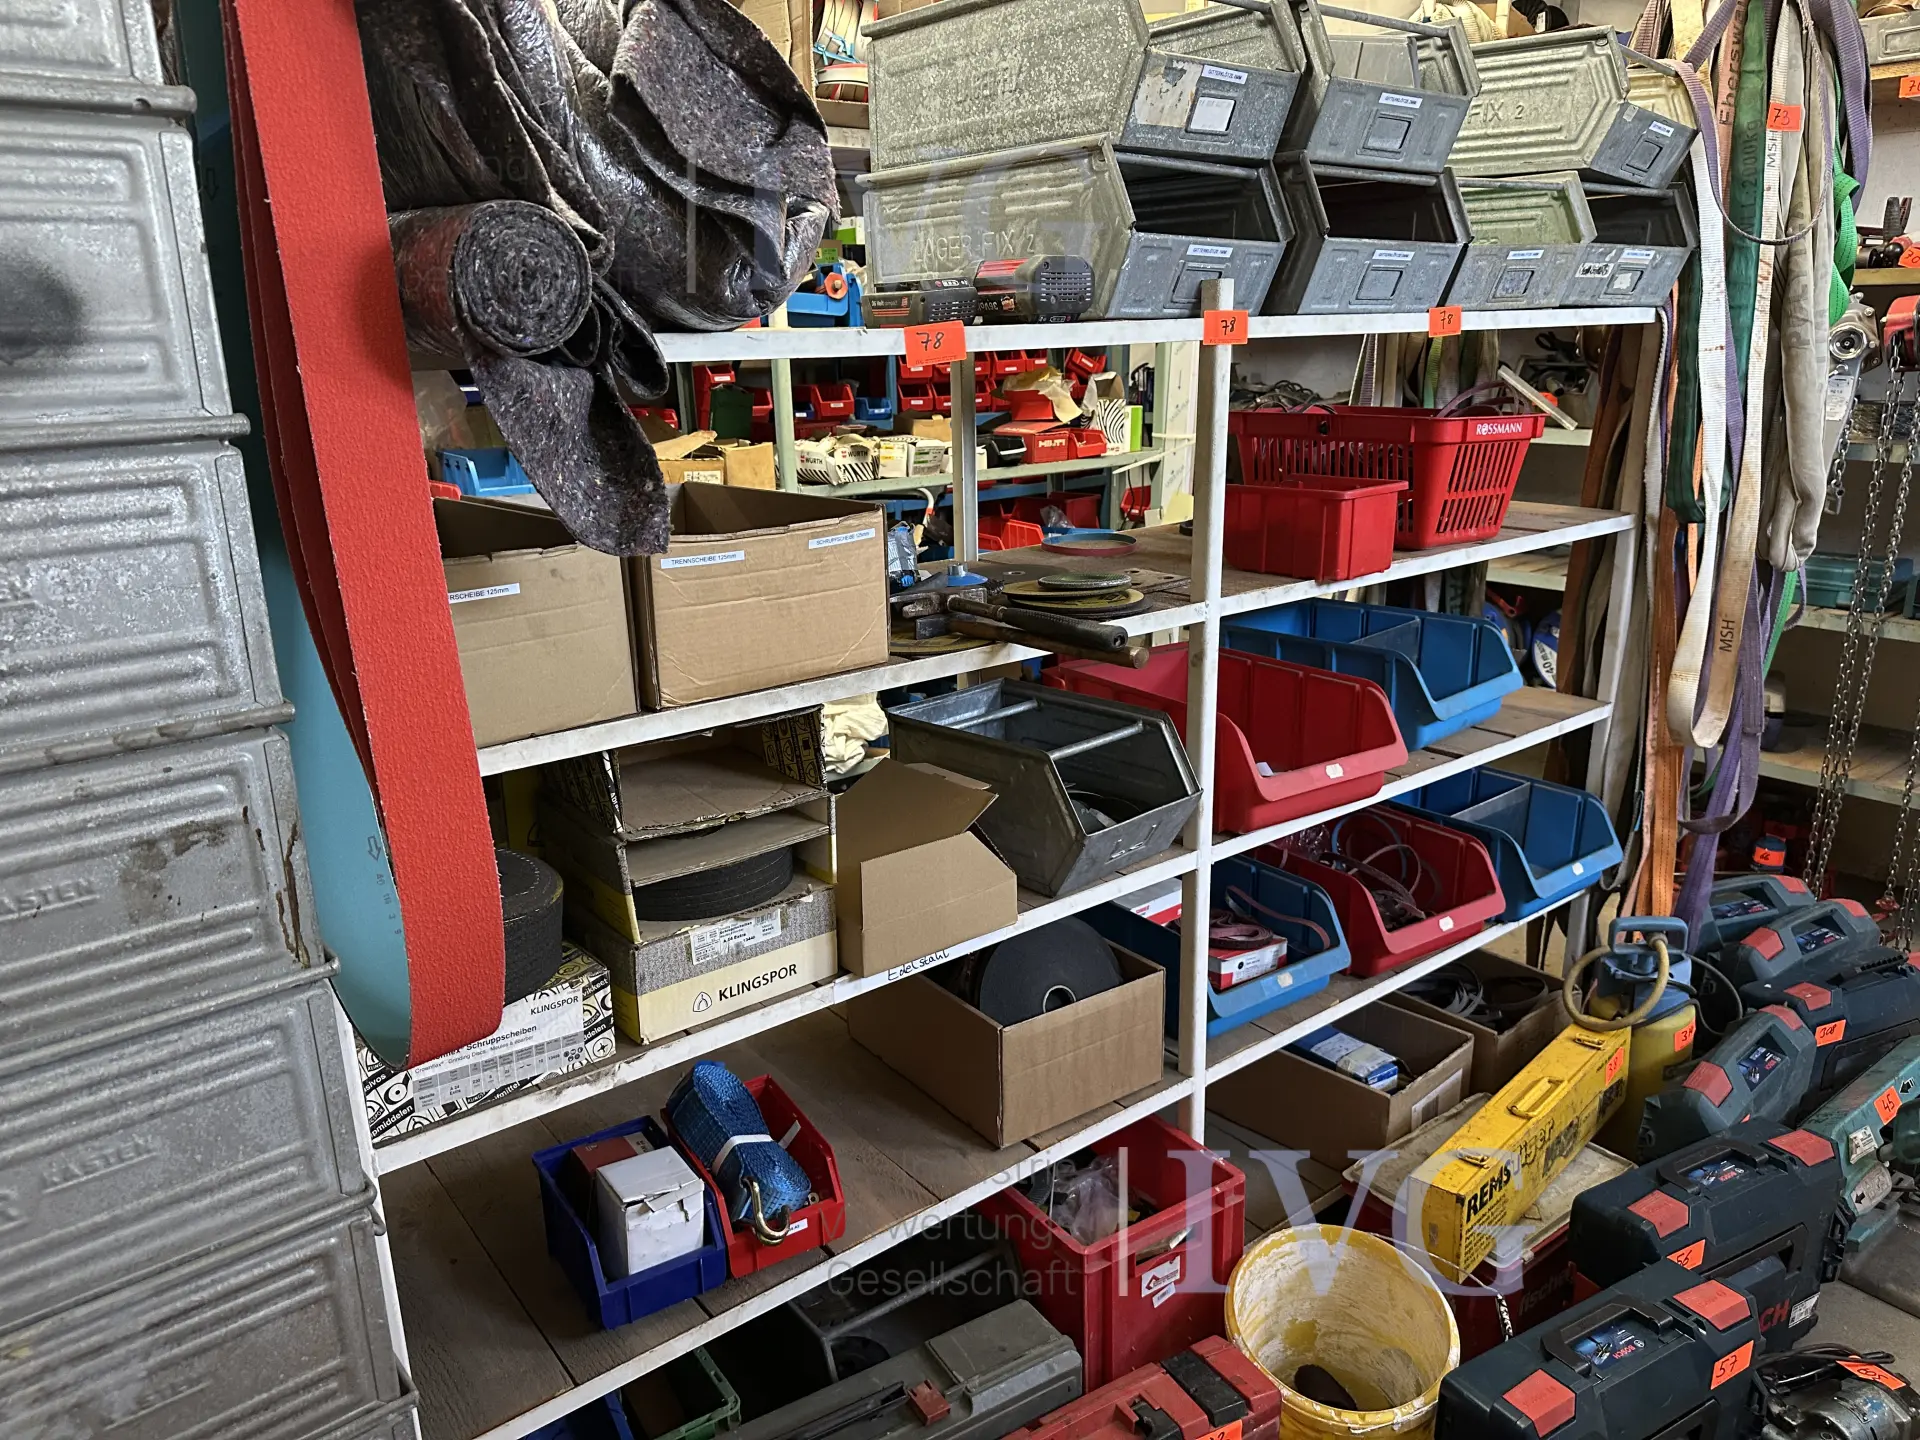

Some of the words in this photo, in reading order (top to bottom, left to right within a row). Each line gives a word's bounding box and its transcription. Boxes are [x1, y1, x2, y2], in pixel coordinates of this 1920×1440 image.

[1773, 107, 1791, 126] 73
[1220, 317, 1237, 336] 78
[1437, 310, 1455, 330] 78
[916, 331, 944, 351] 78
[1476, 422, 1523, 436] ROSSMANN
[1038, 438, 1066, 448] HILTI
[671, 554, 717, 567] TRENNSCHEIBE
[718, 552, 737, 562] 125mm
[486, 586, 510, 596] 125mm
[1718, 619, 1736, 653] MSH
[718, 963, 798, 1002] KLINGSPOR
[530, 994, 579, 1016] KLINGSPOR
[466, 1024, 537, 1052] Schruppscheiben
[1819, 1025, 1837, 1039] 308
[1881, 1093, 1895, 1113] 45
[1465, 1160, 1511, 1223] REMS
[1715, 1354, 1738, 1378] 57
